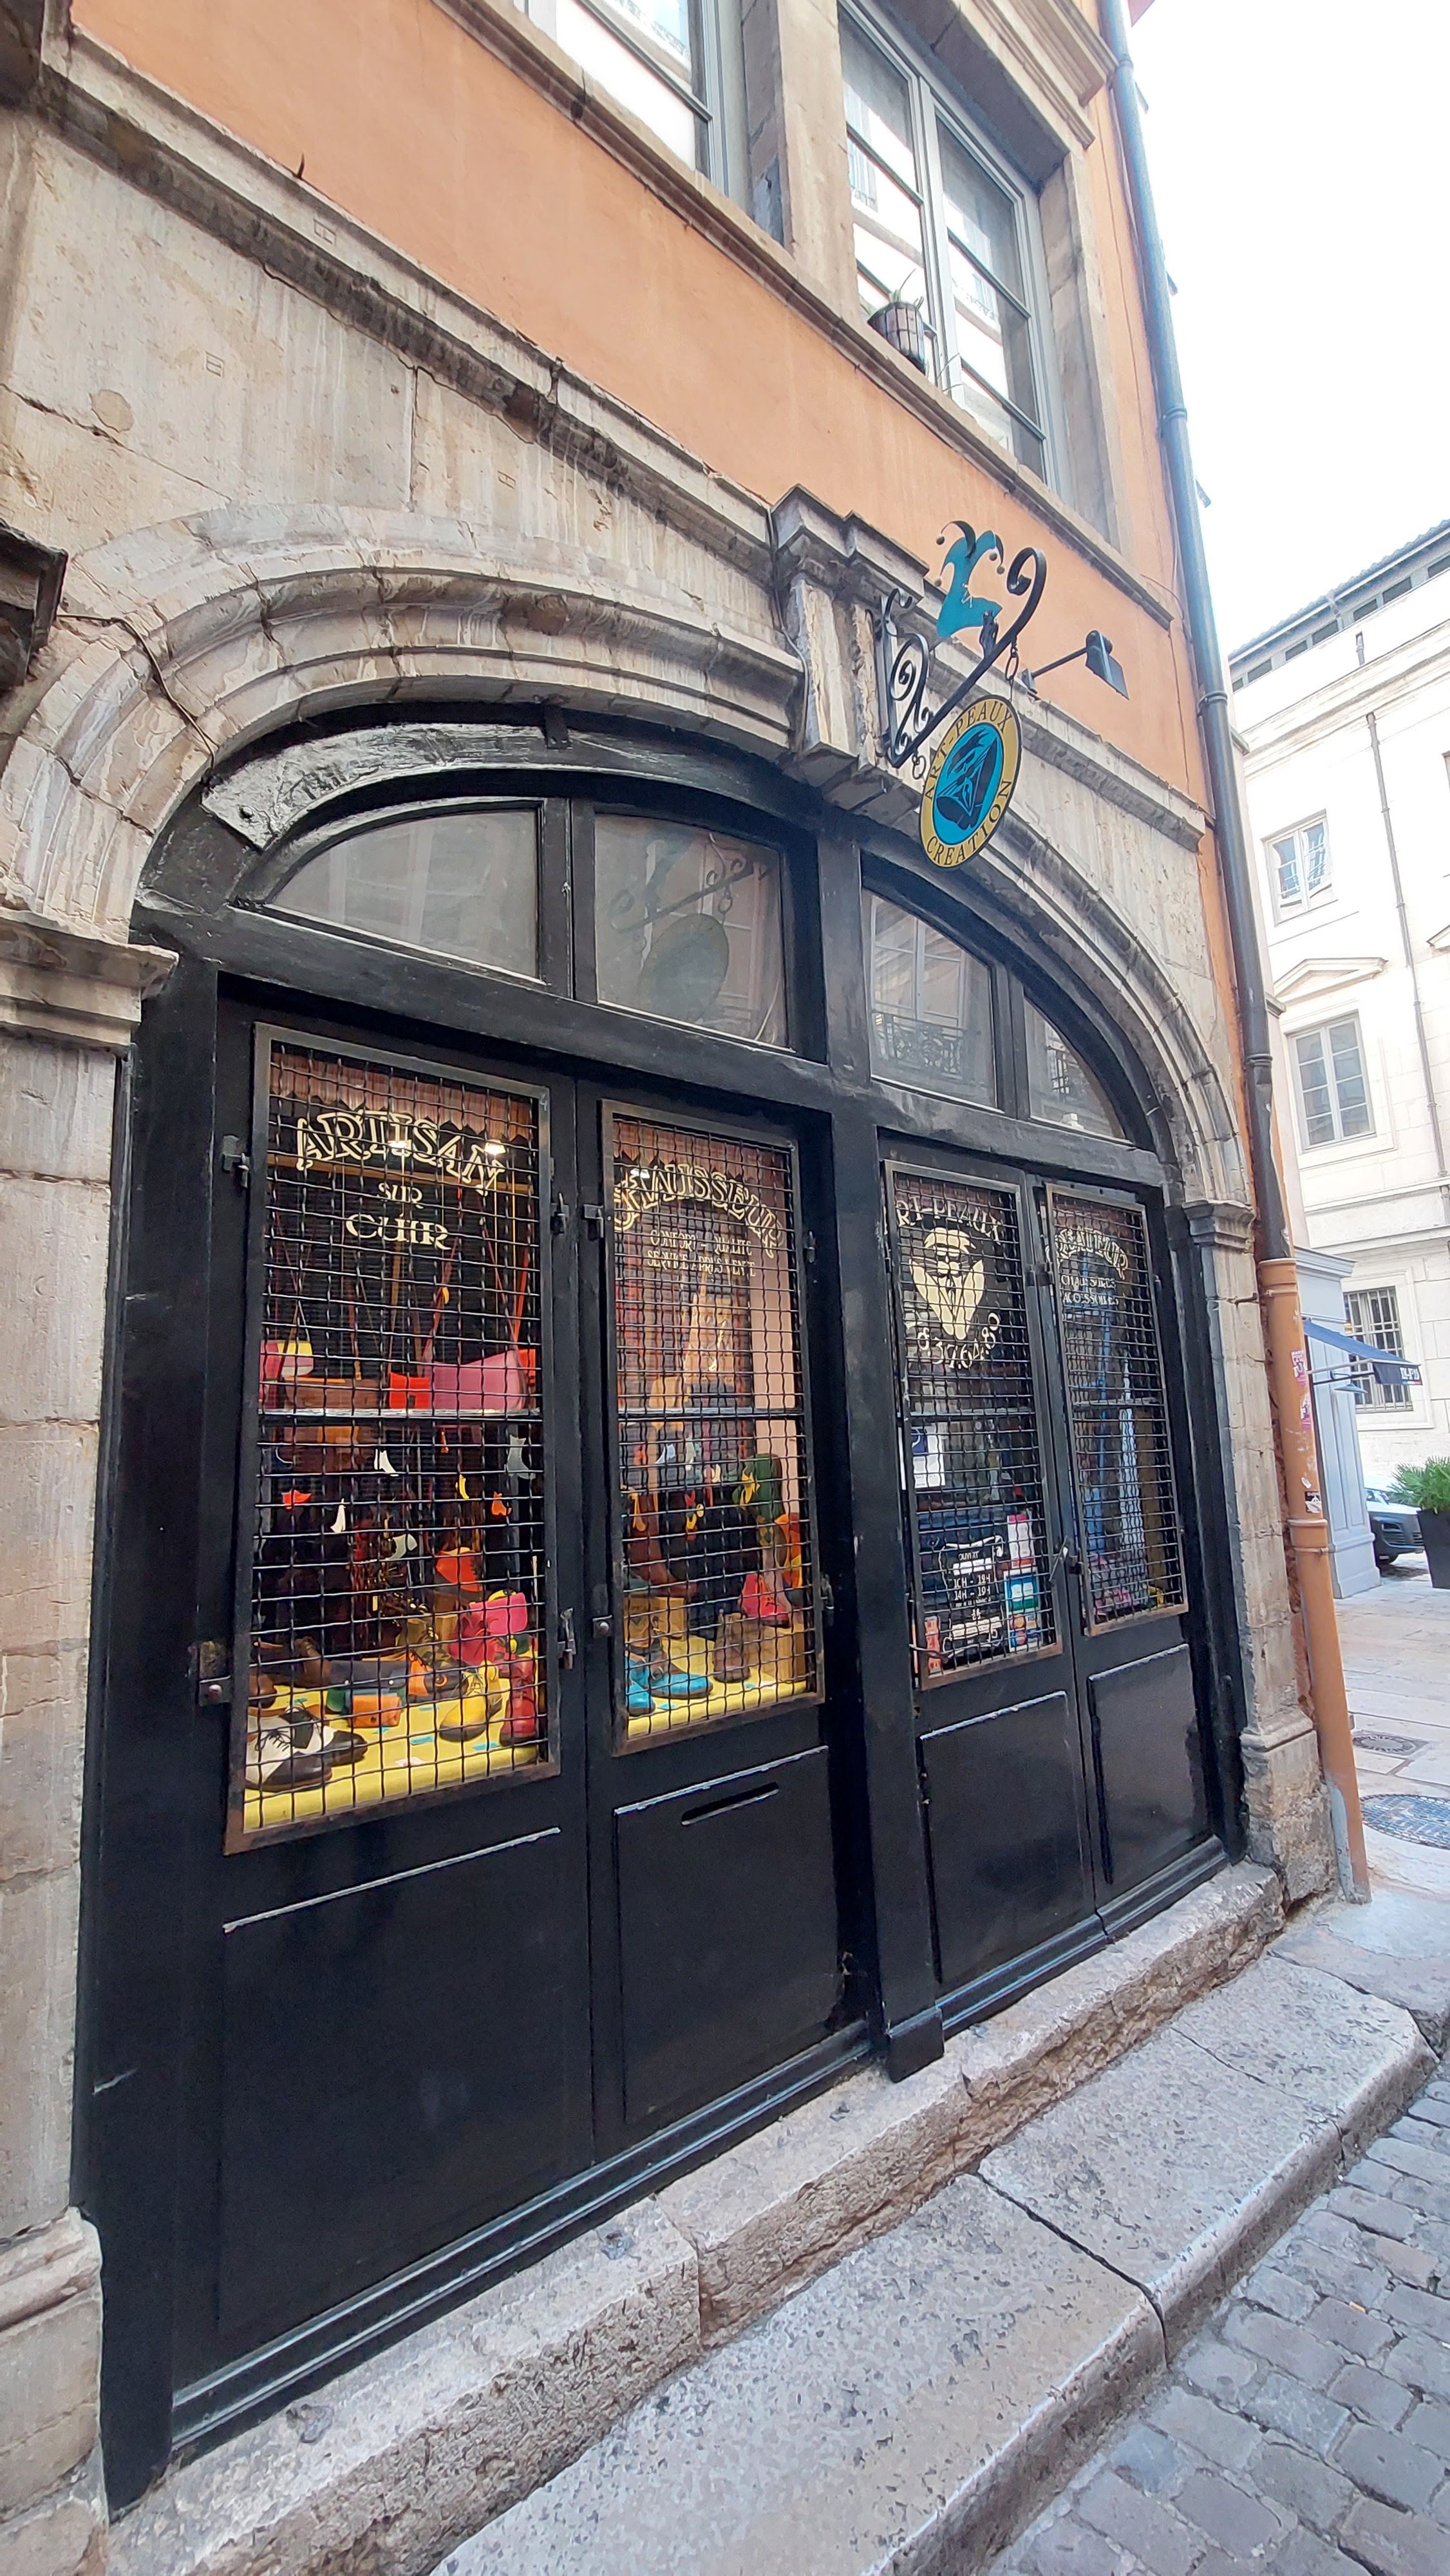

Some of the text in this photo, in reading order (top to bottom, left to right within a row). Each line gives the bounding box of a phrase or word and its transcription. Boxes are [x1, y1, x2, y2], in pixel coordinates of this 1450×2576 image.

[925, 700, 1013, 801] ART-PEAUX
[927, 779, 1013, 866] CREATION
[297, 1110, 505, 1197] ARTISAN
[377, 1182, 424, 1209] SUR
[346, 1214, 451, 1251] CUIR
[650, 1229, 697, 1252] CONFORT
[884, 1195, 1002, 1245] RT-PEAUX
[647, 1250, 689, 1270] SERVICE
